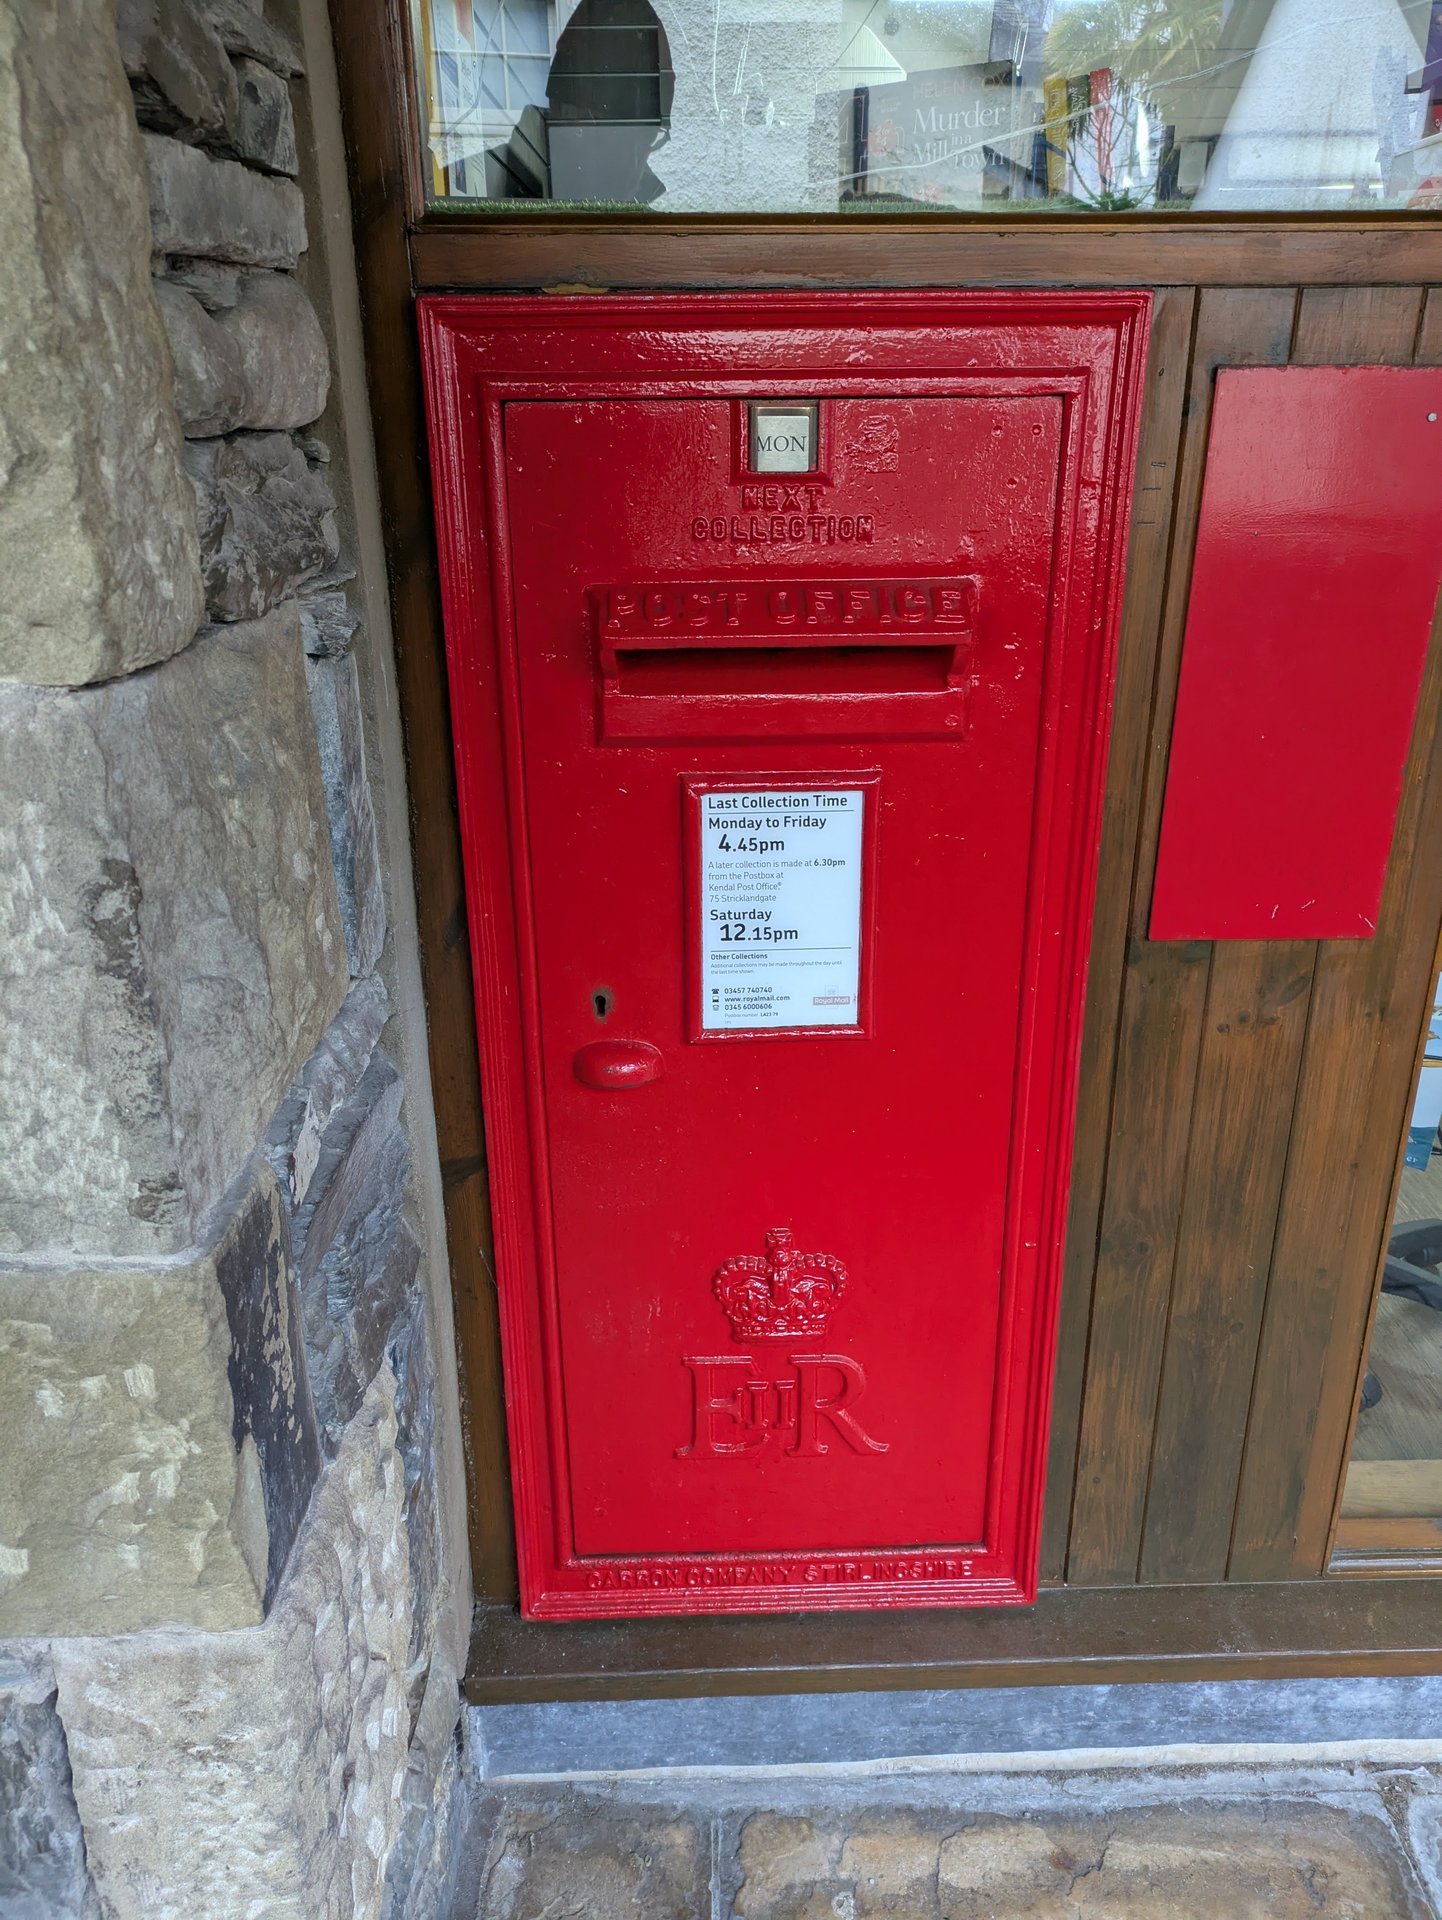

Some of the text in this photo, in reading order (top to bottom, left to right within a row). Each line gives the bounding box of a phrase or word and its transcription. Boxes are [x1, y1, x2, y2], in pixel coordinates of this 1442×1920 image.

[912, 99, 1006, 135] Murder
[912, 139, 948, 164] Mill
[756, 435, 808, 453] MON
[740, 484, 826, 512] NEXT
[691, 515, 876, 544] COLLECTION
[605, 588, 967, 628] POST OFFICE
[708, 794, 848, 809] Last Collection Time
[708, 815, 827, 831] Monday to Friday
[718, 834, 785, 854] 4.45pm
[715, 860, 736, 868] later
[737, 860, 771, 868] collection
[781, 859, 803, 867] made
[813, 858, 846, 868] 6.30pm
[708, 872, 728, 880] from
[729, 872, 742, 880] the
[743, 871, 774, 879] Postbox
[709, 883, 735, 891] Kendal
[737, 882, 754, 890] Post
[710, 893, 777, 903] 75 Stricklandgate
[710, 908, 772, 922] Saturday
[720, 923, 799, 943] 12.15pm
[731, 952, 768, 960] Collections
[724, 986, 773, 995] 03457 740740
[724, 994, 790, 1003] www.royalmail.com
[815, 997, 833, 1005] Royal
[724, 1002, 772, 1011] 0345 6000606
[585, 1560, 973, 1591] CARRON COMPANY STIRLINGSHIRE
